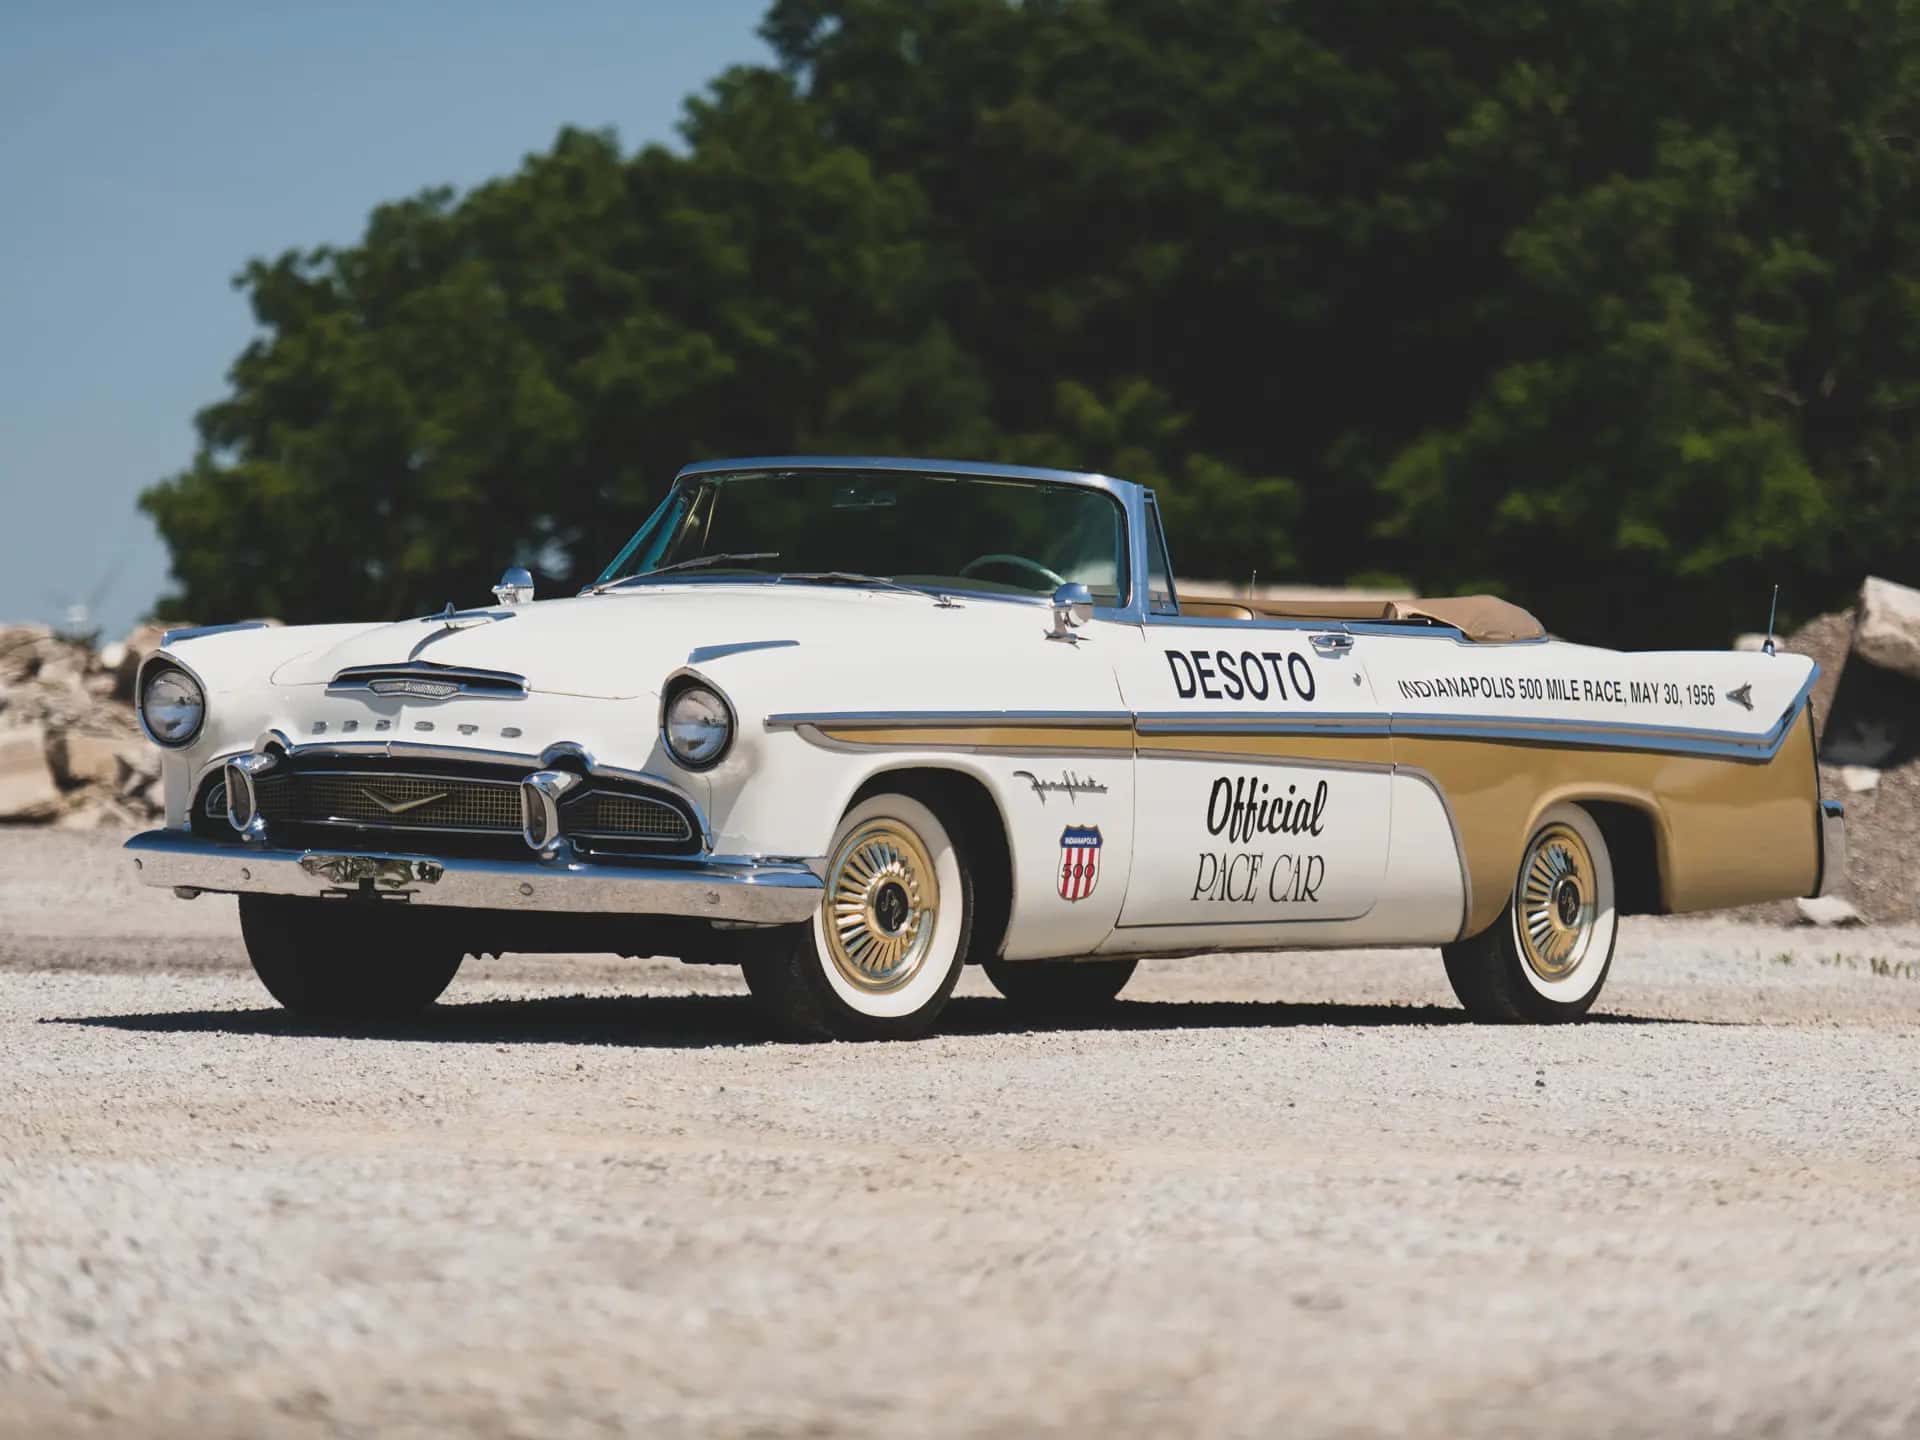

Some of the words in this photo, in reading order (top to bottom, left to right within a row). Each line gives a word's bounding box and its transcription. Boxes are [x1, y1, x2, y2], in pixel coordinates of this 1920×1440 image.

[1164, 649, 1316, 702] DESOTO
[1397, 676, 1516, 699] INDIANAPOLIS
[1518, 678, 1543, 700] 500
[1545, 678, 1581, 701] MILE
[1583, 680, 1627, 707] RACE,
[1629, 681, 1660, 704] MAY
[1663, 683, 1684, 708] 30,
[1686, 684, 1716, 706] 1956
[1206, 776, 1329, 844] Official
[1061, 863, 1096, 879] 500
[1190, 852, 1264, 904] PACE
[1269, 853, 1326, 903] CAR
